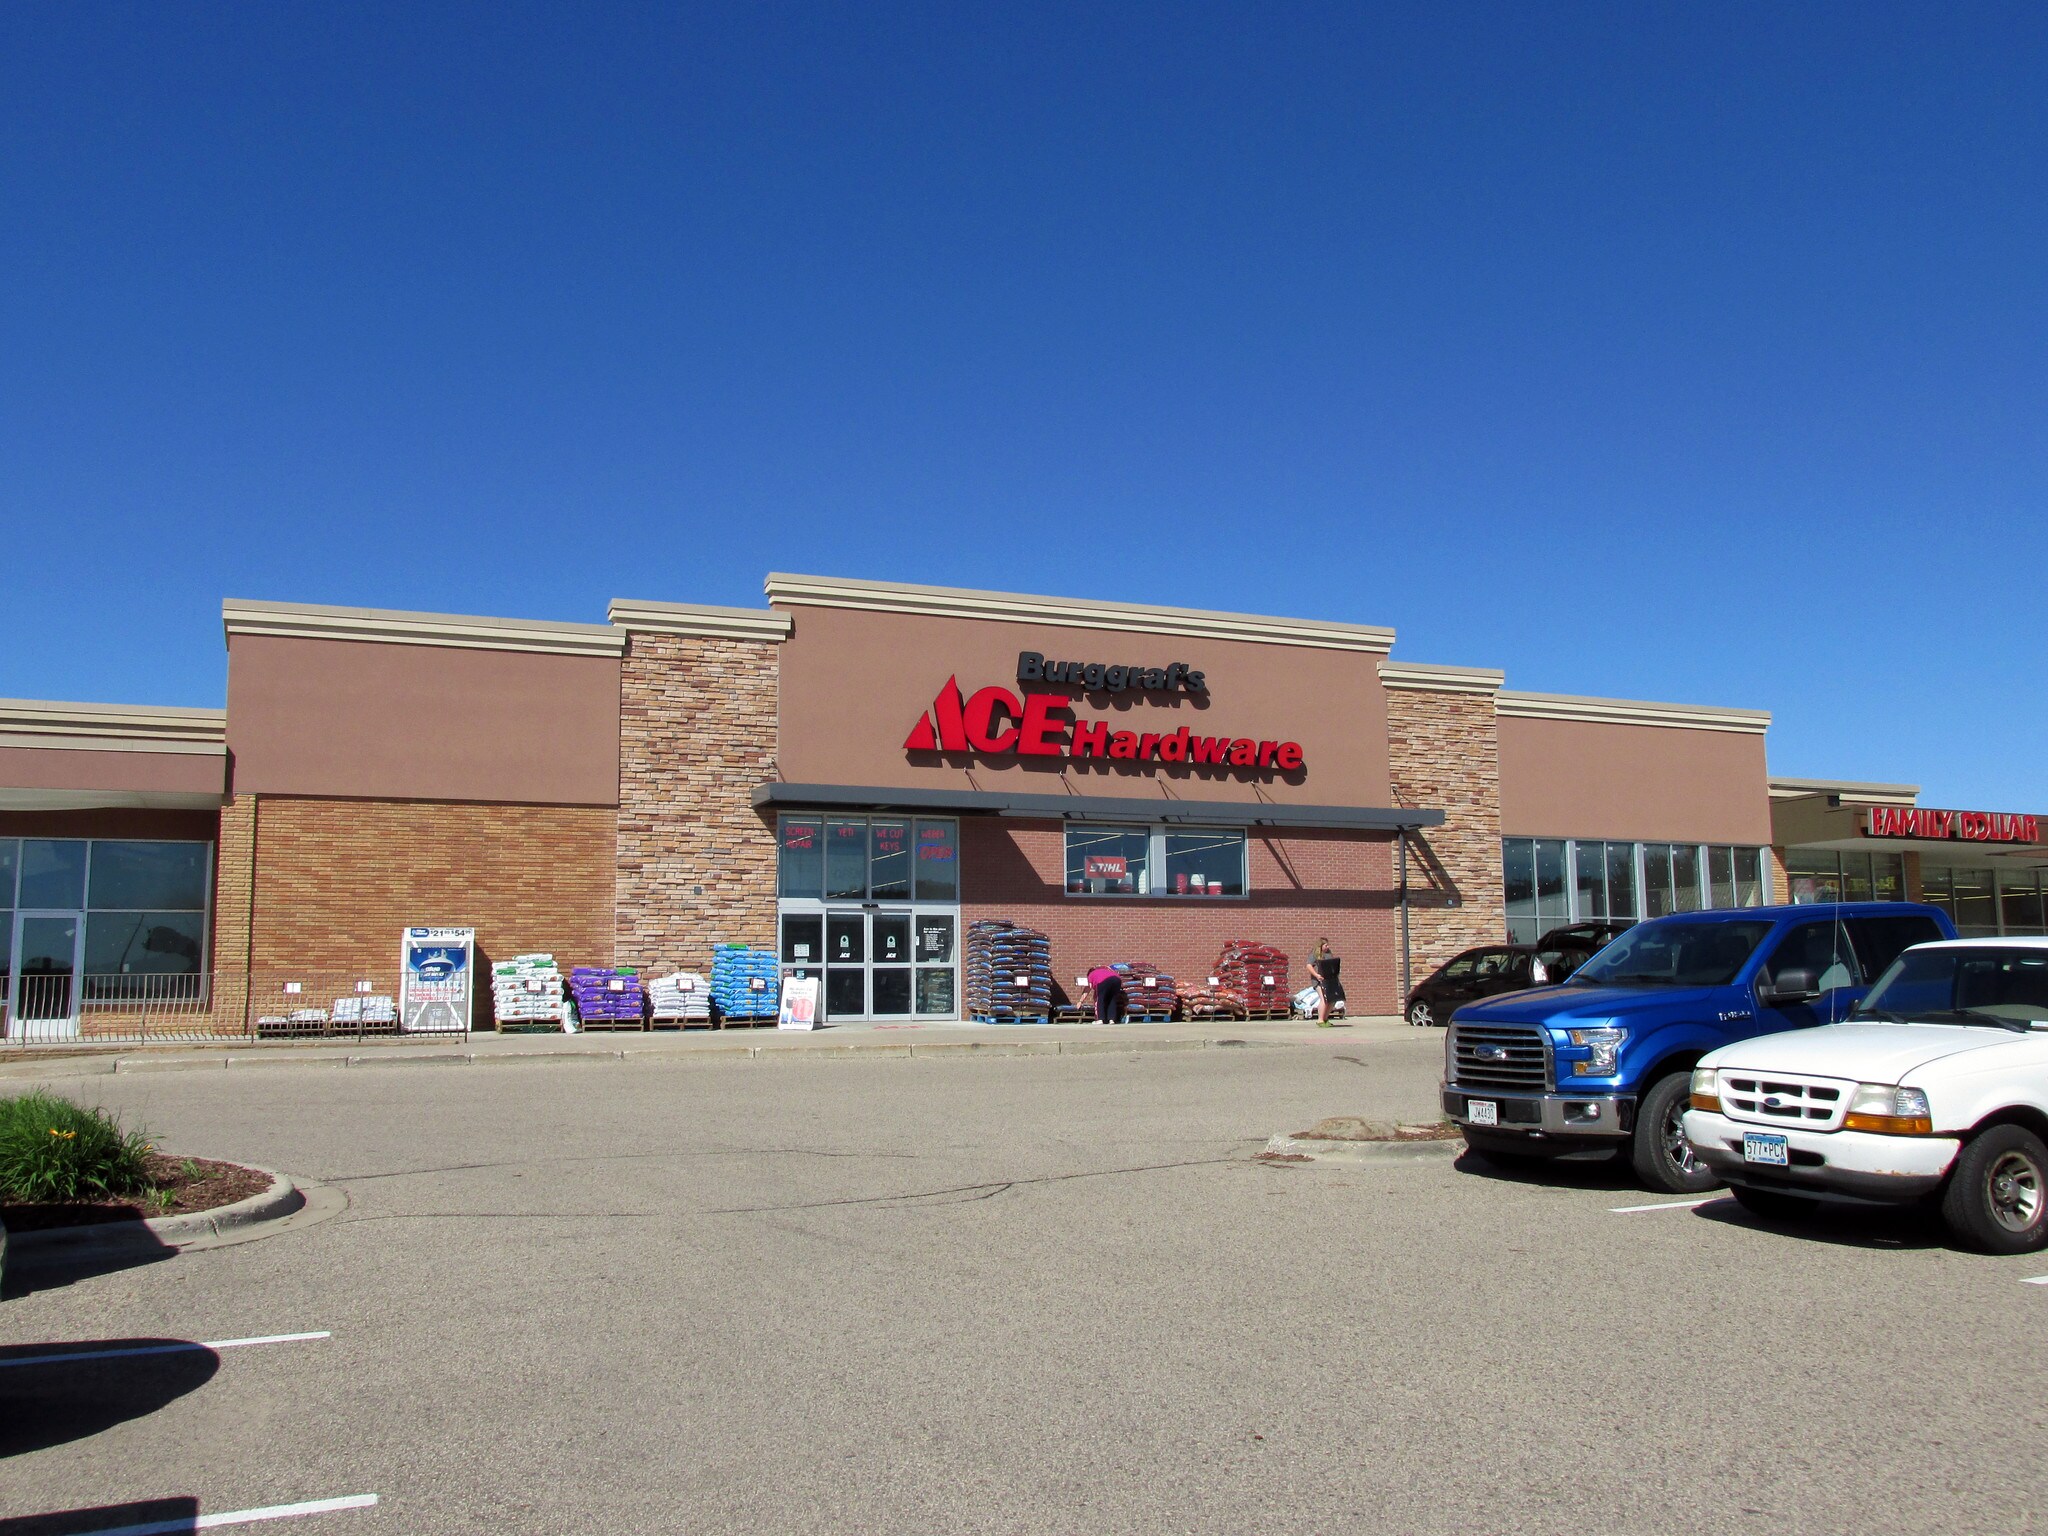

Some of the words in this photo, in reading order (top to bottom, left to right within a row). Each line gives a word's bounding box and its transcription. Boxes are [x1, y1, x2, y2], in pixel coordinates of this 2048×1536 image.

[1016, 651, 1206, 693] Burggraf's
[902, 674, 1069, 755] ACE
[1069, 720, 1304, 770] Hardware
[1870, 807, 1953, 838] FAMILY
[1959, 812, 2039, 842] DOLLAR
[785, 827, 815, 836] SCREEN
[838, 827, 855, 836] YETI
[876, 829, 887, 838] WE
[889, 829, 904, 838] CUT
[921, 829, 945, 838] WEBER
[786, 840, 813, 849] REPAIR
[880, 841, 900, 851] KEYS
[920, 846, 952, 860] OPEN
[1089, 862, 1123, 873] STIHL
[1746, 1141, 1762, 1155] 577
[1769, 1142, 1785, 1157] PCX
